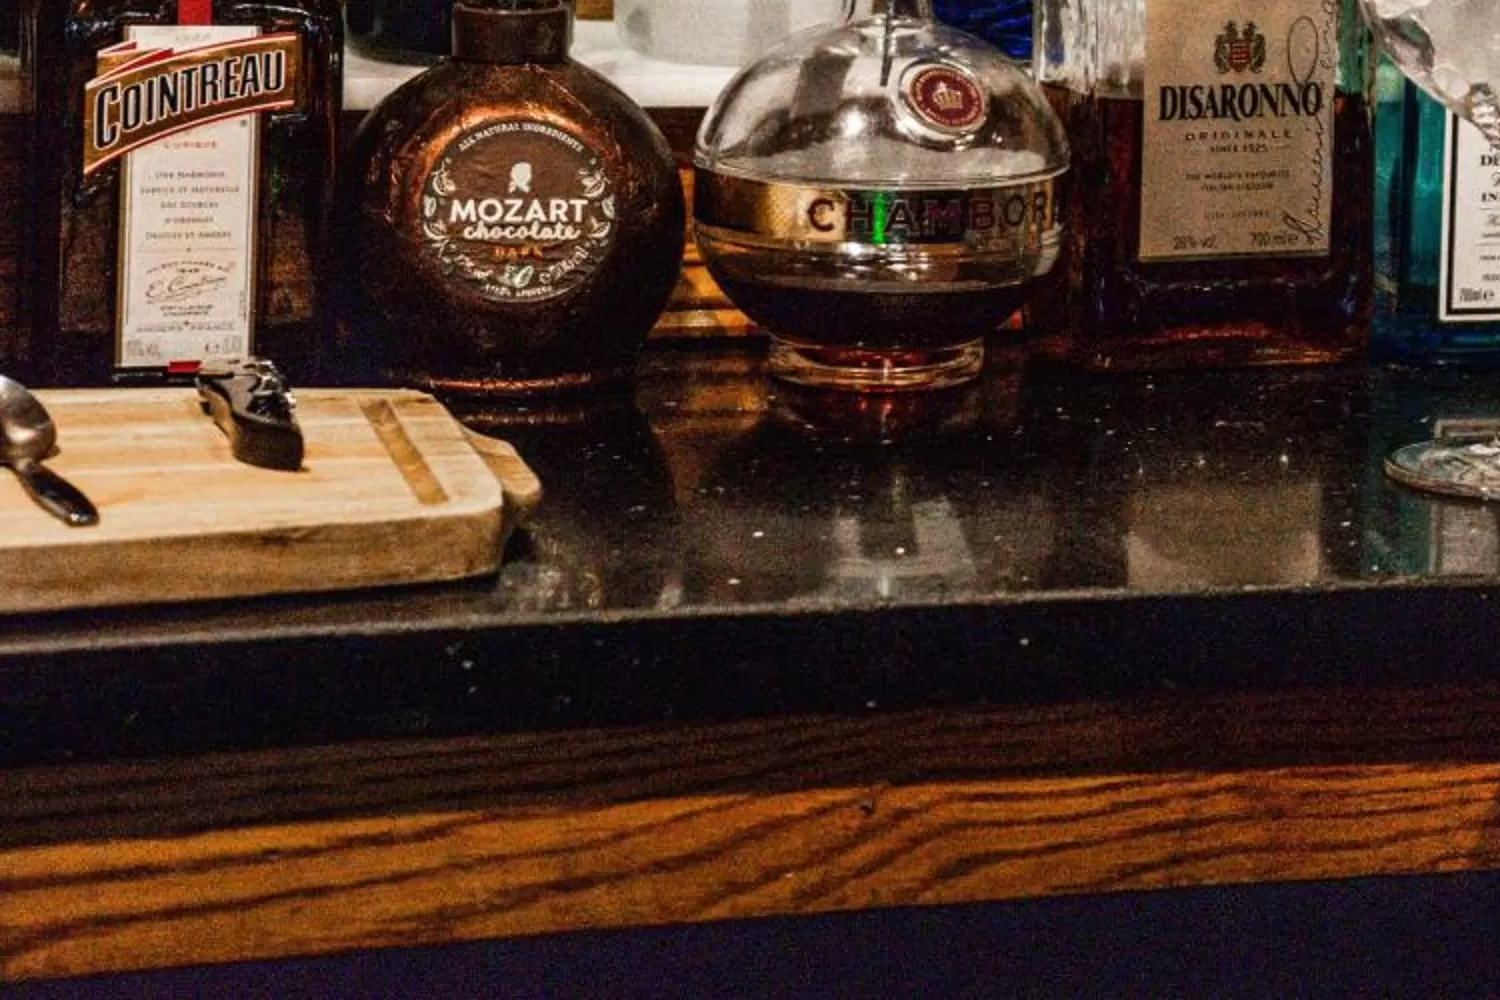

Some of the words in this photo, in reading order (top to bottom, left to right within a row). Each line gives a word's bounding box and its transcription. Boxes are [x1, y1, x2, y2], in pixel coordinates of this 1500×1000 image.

[94, 50, 286, 150] COINTREAU
[1158, 82, 1323, 122] DISARONNO
[450, 199, 589, 224] MOZART
[462, 221, 582, 241] chocolate
[806, 190, 1052, 237] CHAMBOR
